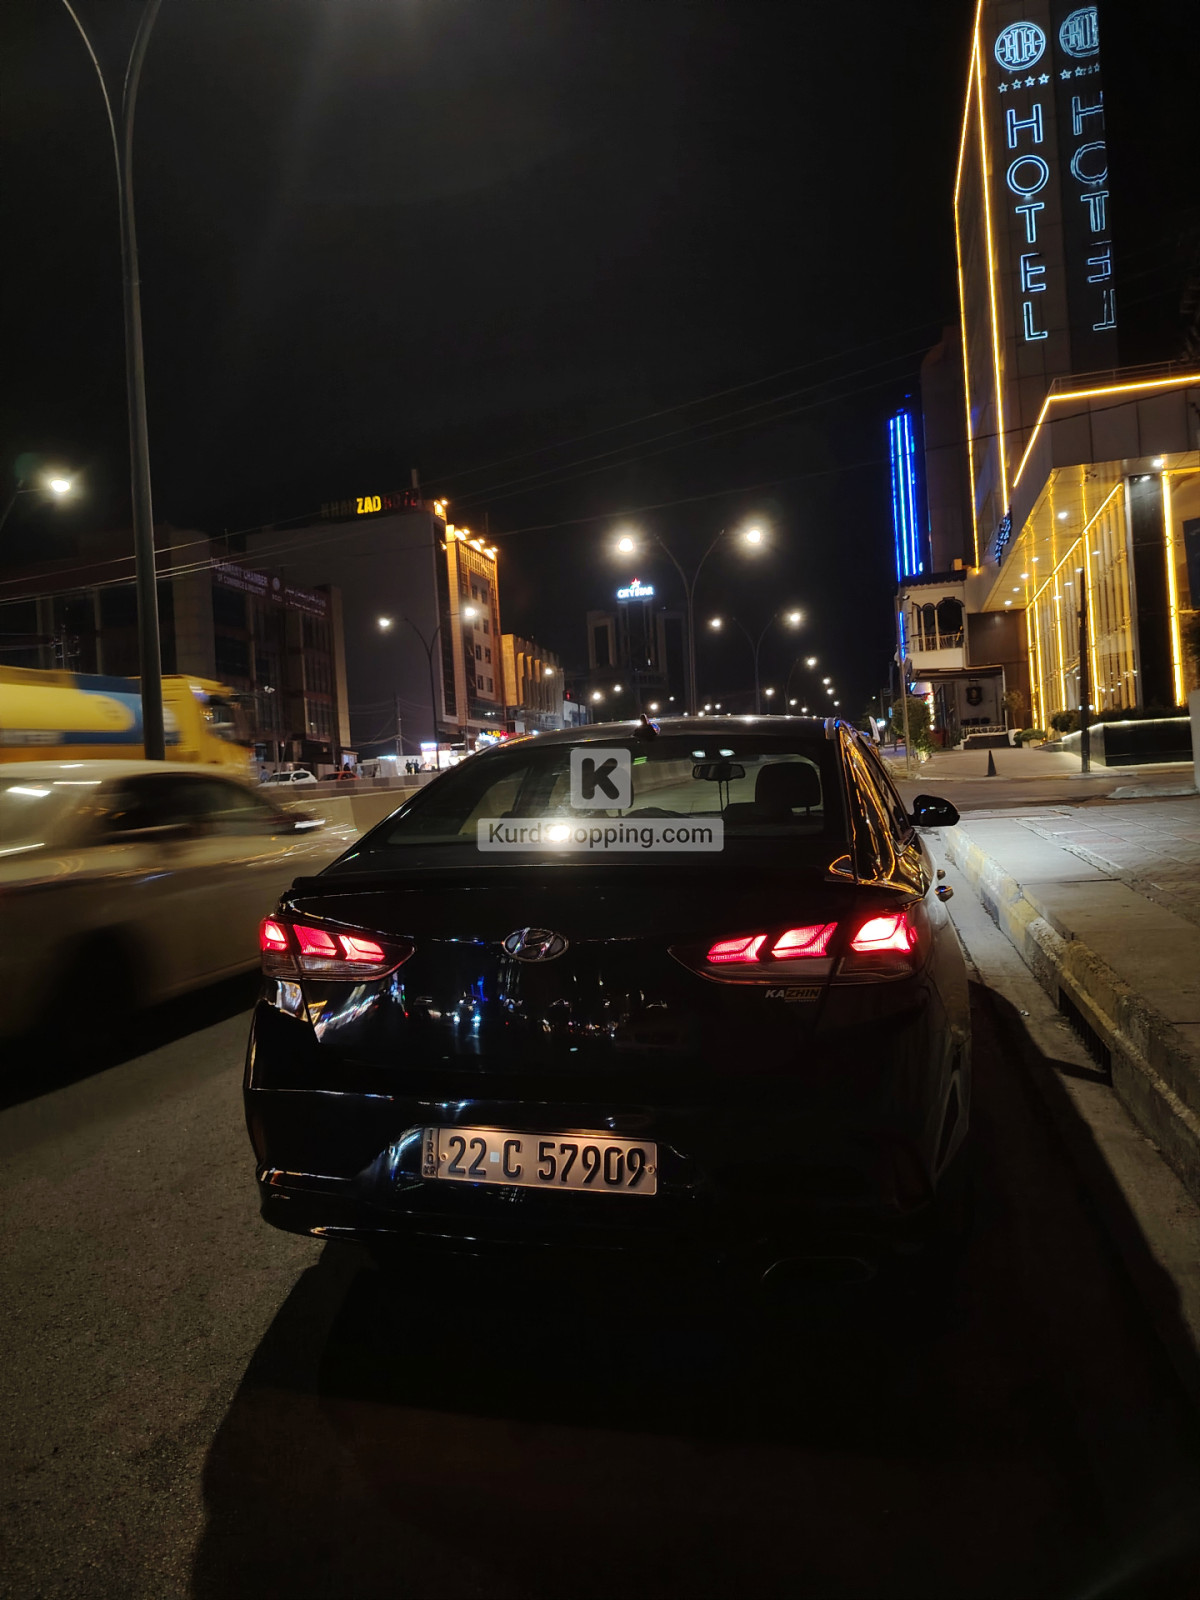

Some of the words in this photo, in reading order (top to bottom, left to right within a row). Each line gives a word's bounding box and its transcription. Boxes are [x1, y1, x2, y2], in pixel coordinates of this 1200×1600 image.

[1006, 103, 1050, 341] HOTEL
[448, 1135, 487, 1176] 22
[502, 1140, 522, 1178] C
[538, 1141, 647, 1187] 57909
